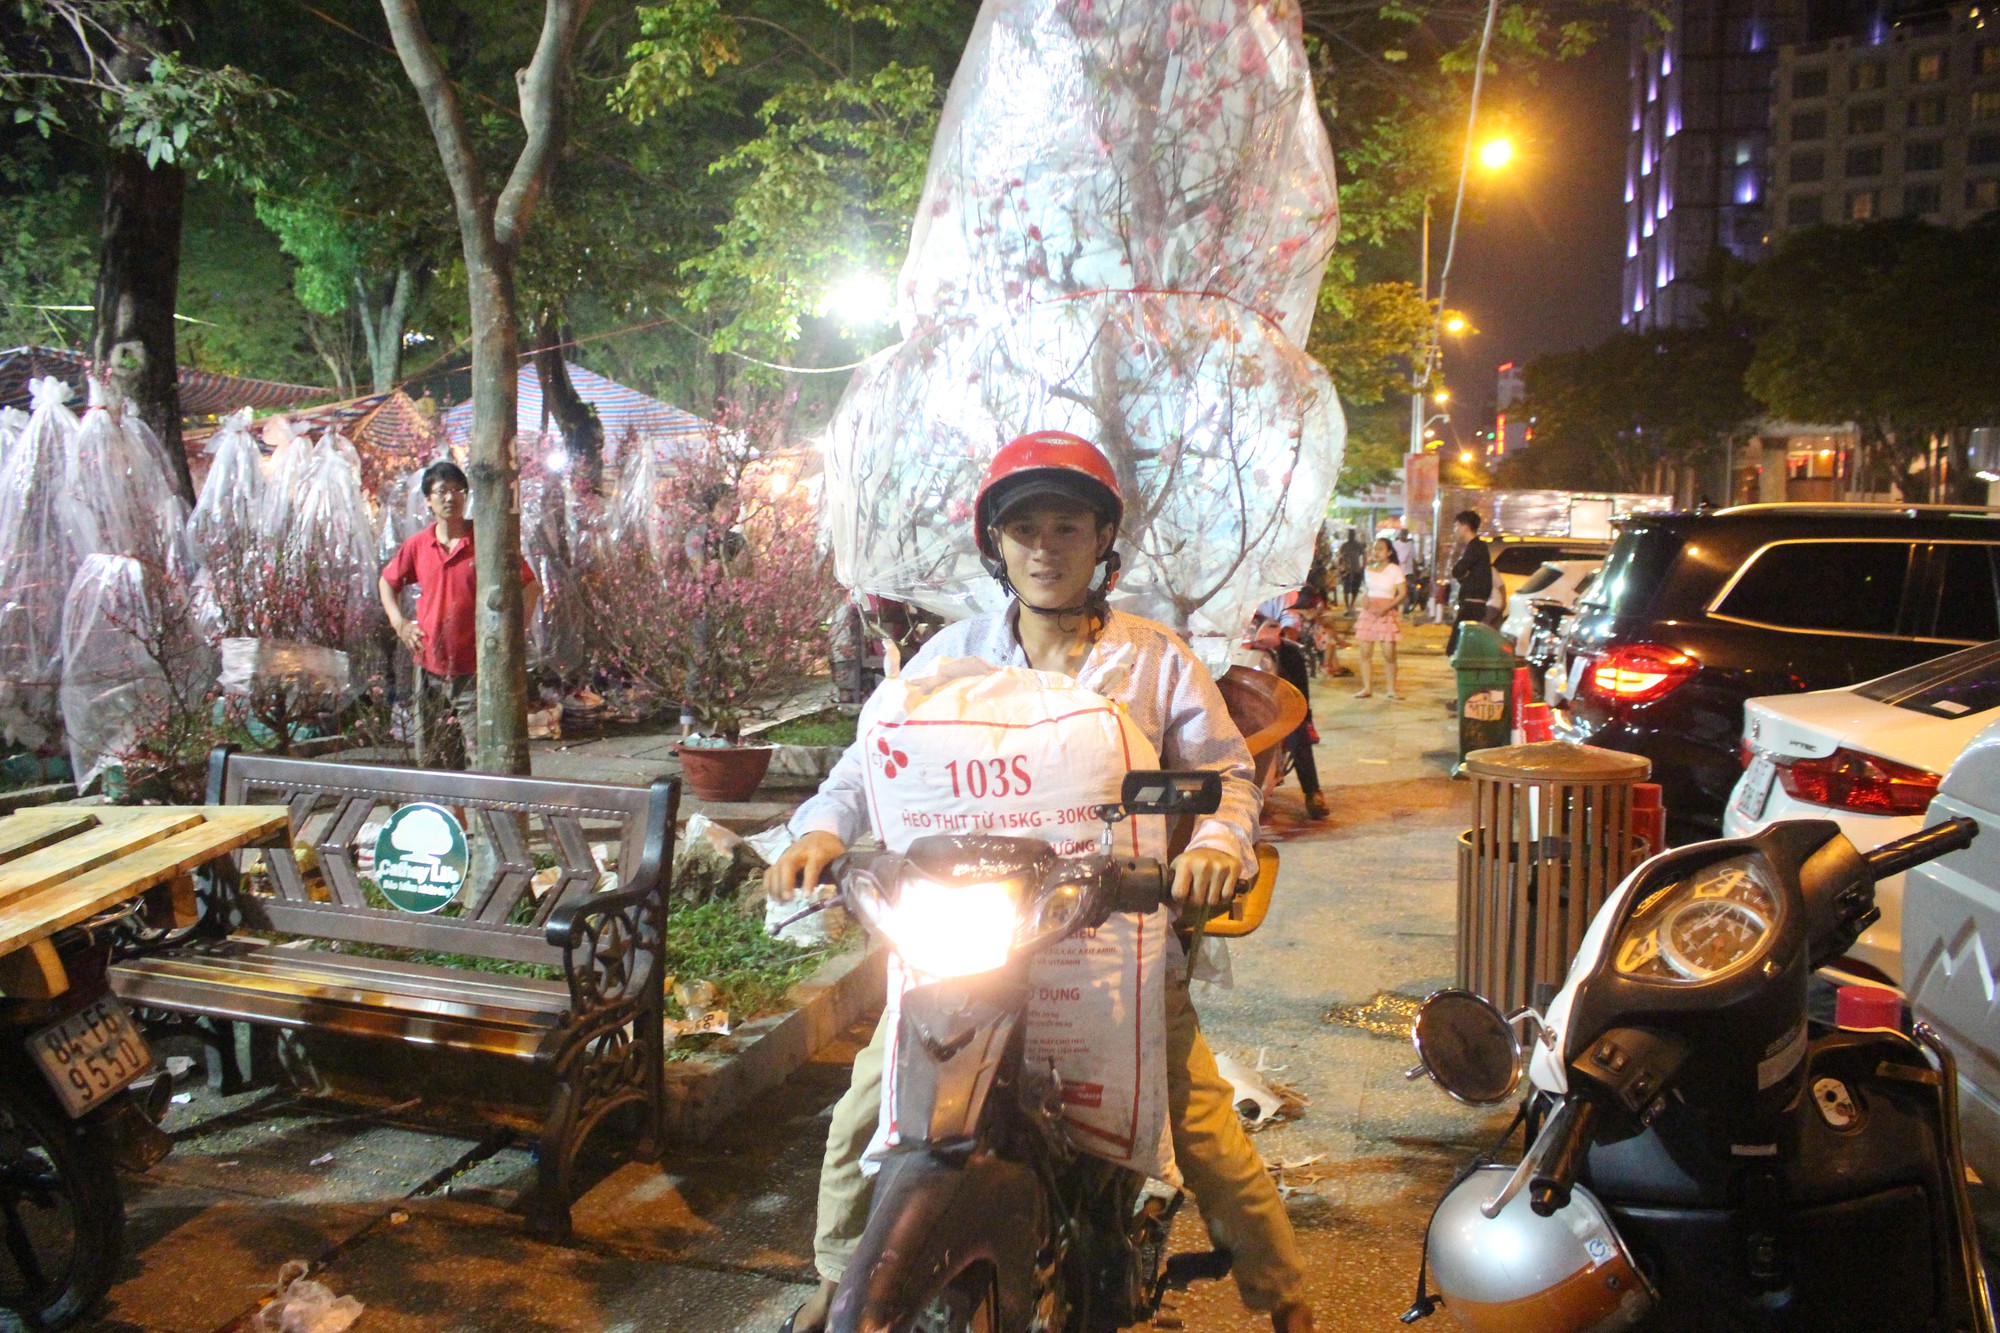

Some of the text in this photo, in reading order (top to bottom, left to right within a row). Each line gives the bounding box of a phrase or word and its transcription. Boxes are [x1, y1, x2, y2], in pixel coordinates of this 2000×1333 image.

[944, 754, 1032, 799] 103S
[902, 812, 931, 829] HEO
[933, 813, 968, 832] THỊT
[972, 810, 994, 830] TỪ
[1000, 811, 1041, 829] 15KG
[1057, 804, 1099, 825] 30KG
[1053, 838, 1095, 857] ƯỠNG
[379, 859, 460, 885] Cathay Life
[69, 1038, 140, 1100] 9550
